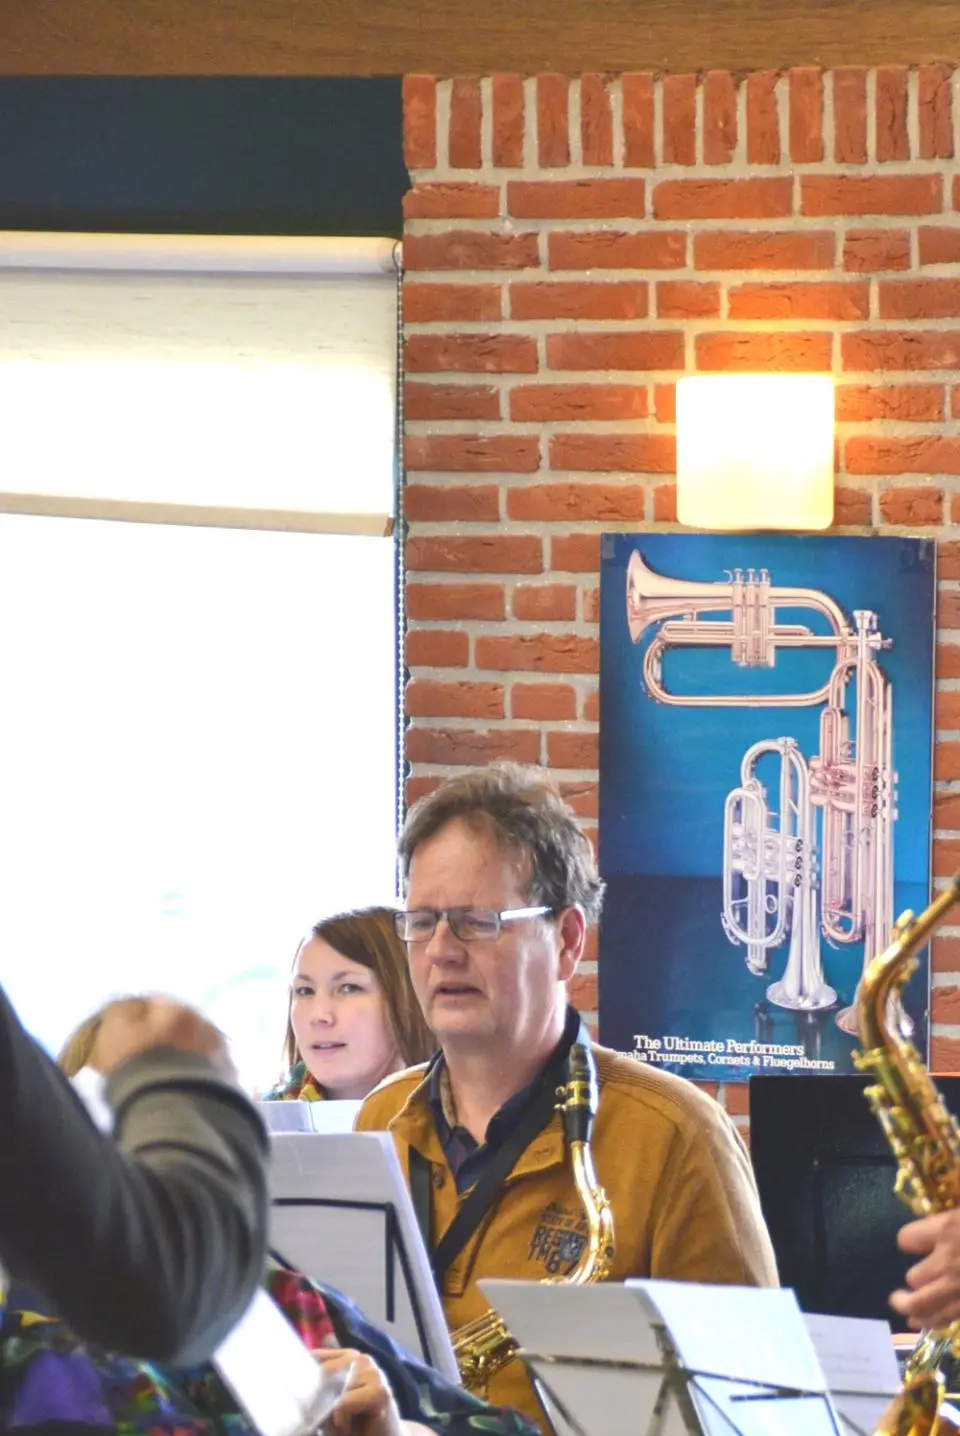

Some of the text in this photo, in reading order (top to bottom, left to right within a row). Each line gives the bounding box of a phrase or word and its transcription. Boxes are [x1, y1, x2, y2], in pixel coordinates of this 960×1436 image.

[633, 1034, 805, 1056] The Ultimate Performers
[648, 1050, 706, 1065] Trumpets,
[707, 1053, 751, 1066] Cornets
[752, 1056, 760, 1066] &
[762, 1055, 835, 1070] Fluegelhorns
